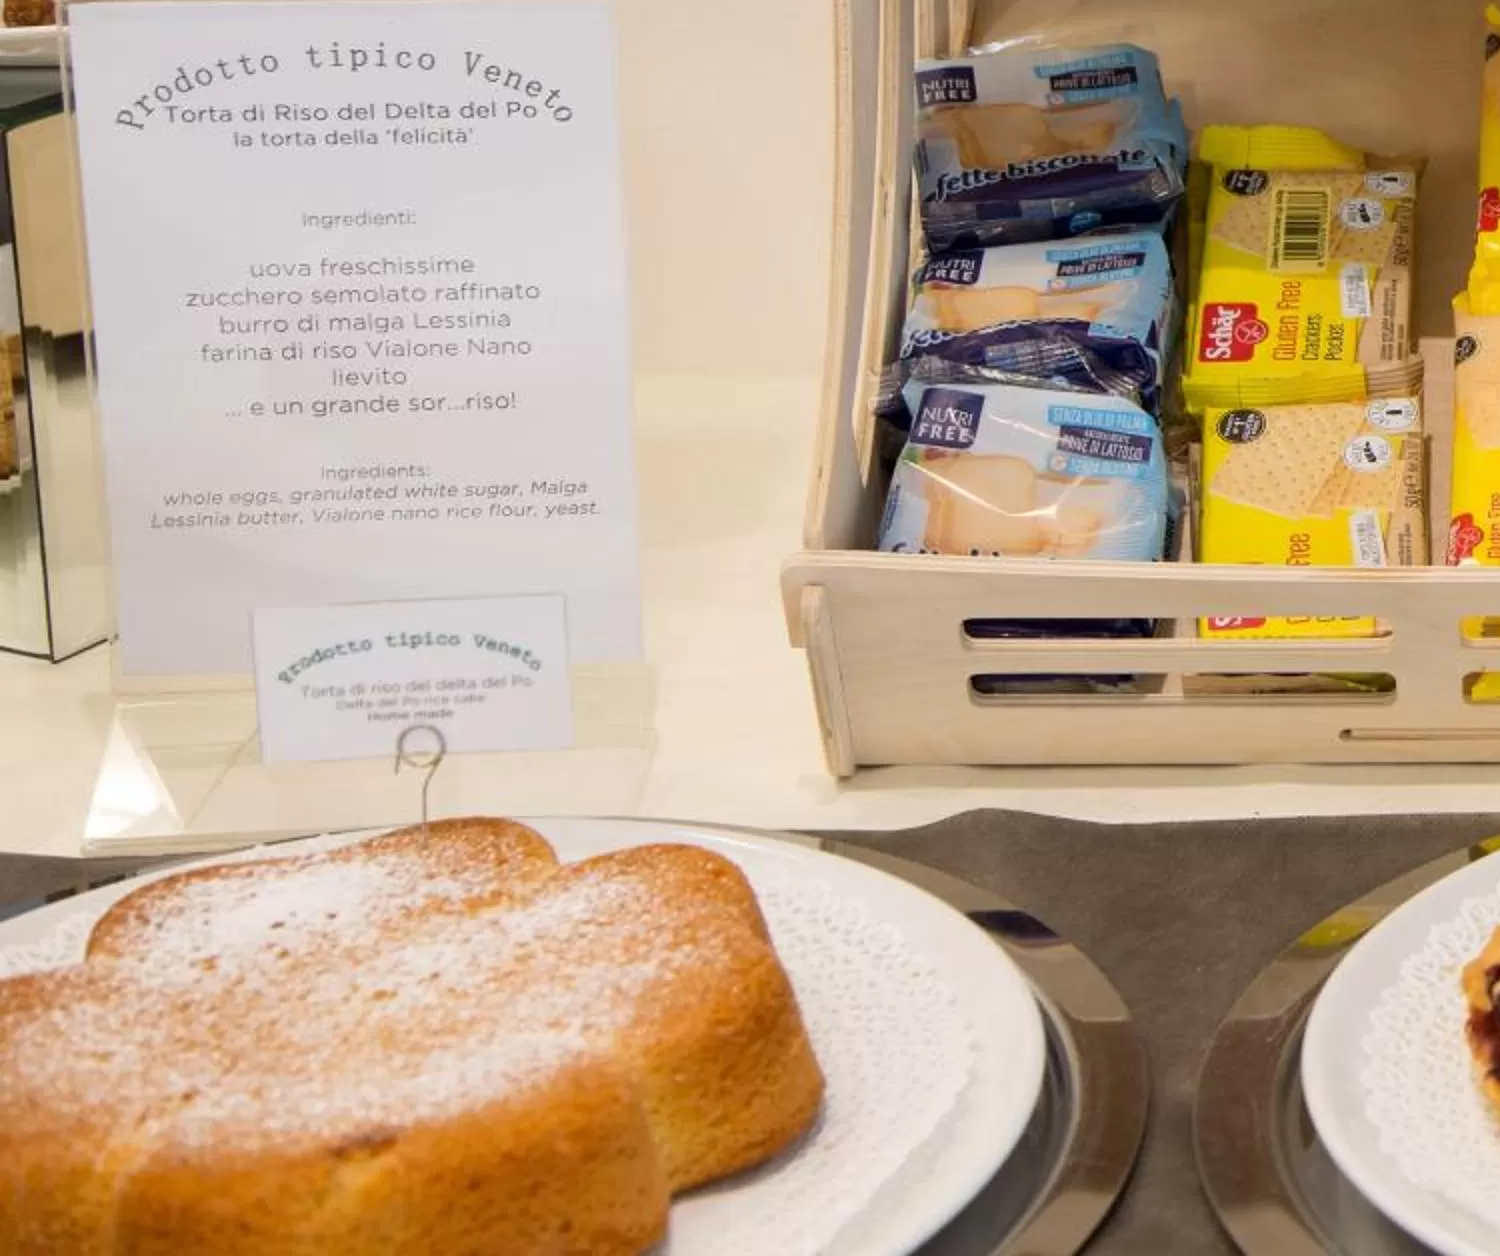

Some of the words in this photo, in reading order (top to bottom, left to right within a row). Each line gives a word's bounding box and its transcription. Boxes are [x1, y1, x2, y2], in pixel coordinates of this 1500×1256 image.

[116, 52, 279, 130] Prodotto
[305, 42, 437, 72] tipico
[464, 51, 574, 123] Veneto
[921, 78, 970, 93] NUTRI
[923, 90, 970, 103] FREE
[164, 105, 233, 124] Torta
[242, 104, 265, 122] di
[275, 104, 329, 122] Riso
[337, 103, 376, 121] del
[385, 103, 450, 121] Delta
[460, 101, 497, 119] del
[507, 102, 538, 119] Po
[234, 131, 254, 148] la
[261, 131, 317, 147] torta
[324, 130, 379, 146] della
[302, 210, 417, 230] Ingredienti:
[249, 262, 312, 279] uova
[320, 255, 476, 277] freschissime
[923, 270, 976, 283] FREE
[185, 287, 304, 308] zucchero
[311, 285, 428, 305] semolato
[434, 282, 541, 302] raffinato
[1277, 280, 1302, 310] Free
[219, 315, 290, 335] burro
[298, 314, 320, 333] di
[328, 314, 406, 335] malga
[413, 310, 512, 330] Lessinia
[1206, 306, 1241, 359] Schär
[201, 342, 273, 362] farina
[281, 341, 304, 361] di
[312, 341, 358, 360] riso
[365, 339, 460, 358] Vialone
[467, 337, 533, 356] Nano
[1272, 314, 1300, 362] Gluten
[332, 368, 408, 387] lievito
[250, 401, 266, 417] e
[273, 399, 304, 416] un
[311, 394, 401, 418] grande
[922, 406, 974, 428] NUTRI
[916, 423, 975, 443] FREE
[163, 489, 224, 508] whole
[290, 483, 398, 505] granulated
[404, 481, 459, 499] white
[464, 481, 524, 500] sugar,
[531, 479, 589, 499] Malga
[151, 510, 231, 529] Lessinia
[237, 508, 304, 527] butter,
[313, 505, 385, 524] Vialone
[391, 506, 439, 521] nano
[446, 502, 483, 520] rice
[488, 499, 538, 519] flour,
[1286, 533, 1311, 566] Free
[277, 638, 374, 685] Prodotto
[384, 631, 462, 649] tipico
[473, 633, 542, 672] Veneto
[301, 684, 346, 700] Torta
[350, 682, 365, 696] di
[371, 680, 400, 694] riso
[404, 679, 430, 693] del
[435, 677, 477, 691] delta
[482, 676, 506, 689] del
[511, 675, 534, 688] Po
[414, 709, 454, 721] made
